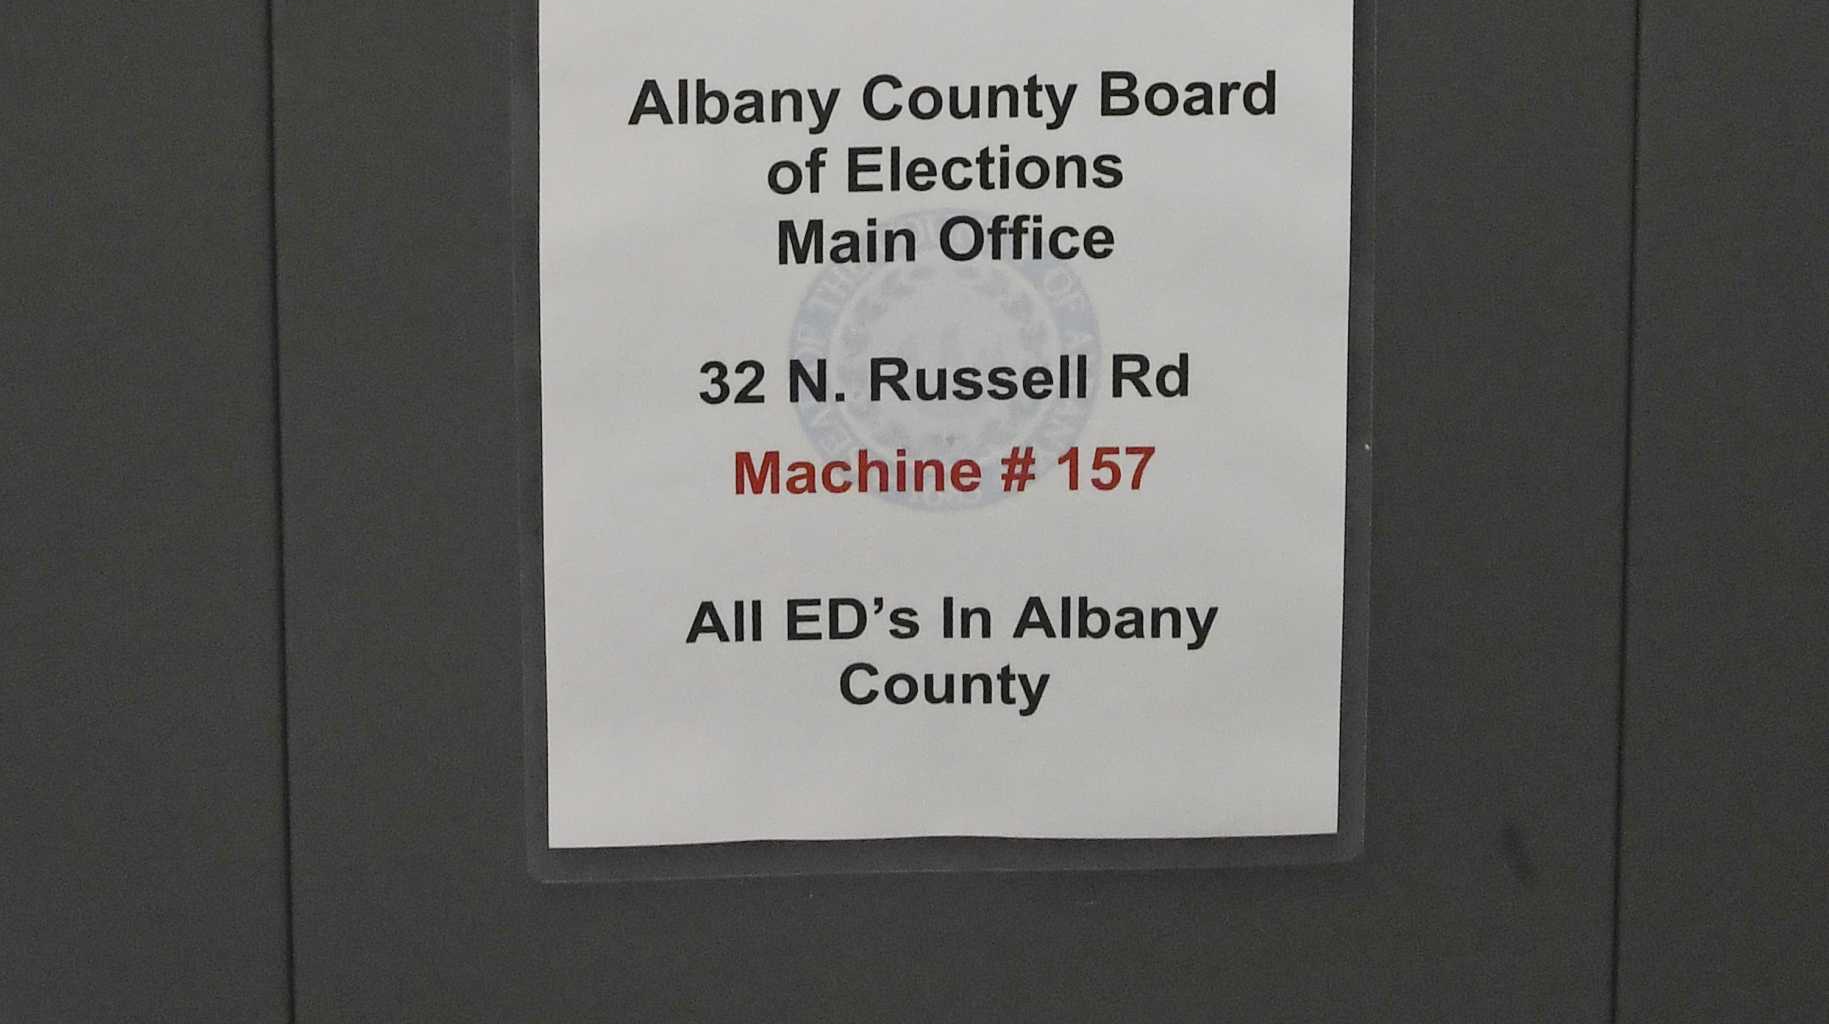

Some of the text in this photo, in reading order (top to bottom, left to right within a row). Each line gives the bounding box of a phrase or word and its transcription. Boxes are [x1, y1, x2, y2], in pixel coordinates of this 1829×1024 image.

[628, 70, 1276, 135] Albany County Board
[767, 144, 1124, 196] of Elections
[778, 218, 916, 266] Main
[939, 214, 1115, 262] Office
[699, 352, 1189, 405] 32 N. Russell Rd
[735, 446, 1156, 495] Machine # 157
[685, 595, 1219, 651] All ED’s In Albany
[839, 662, 1051, 717] County
